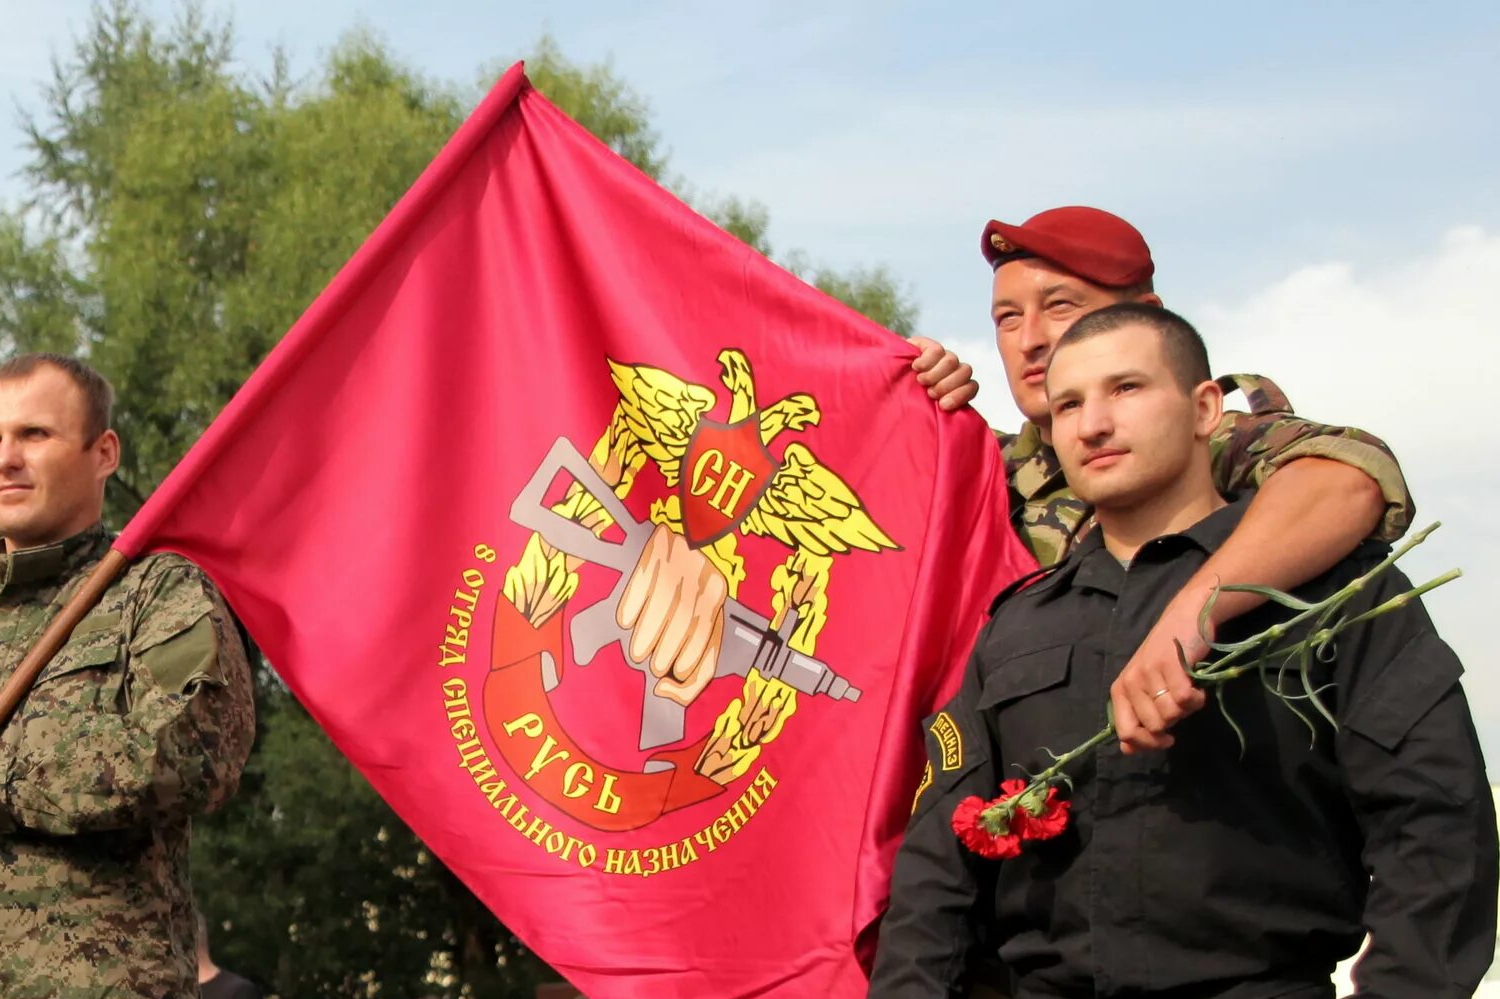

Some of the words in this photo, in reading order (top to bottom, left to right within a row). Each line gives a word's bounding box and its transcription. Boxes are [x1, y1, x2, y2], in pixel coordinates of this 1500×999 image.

[690, 448, 756, 519] СН
[474, 543, 497, 563] 8
[438, 568, 485, 667] ОТРЯД
[442, 677, 598, 868] СПЕЦИАЛЬНОГО
[502, 712, 623, 814] РУСЬ
[603, 766, 779, 877] НАЗНАЧЕНИЯ
